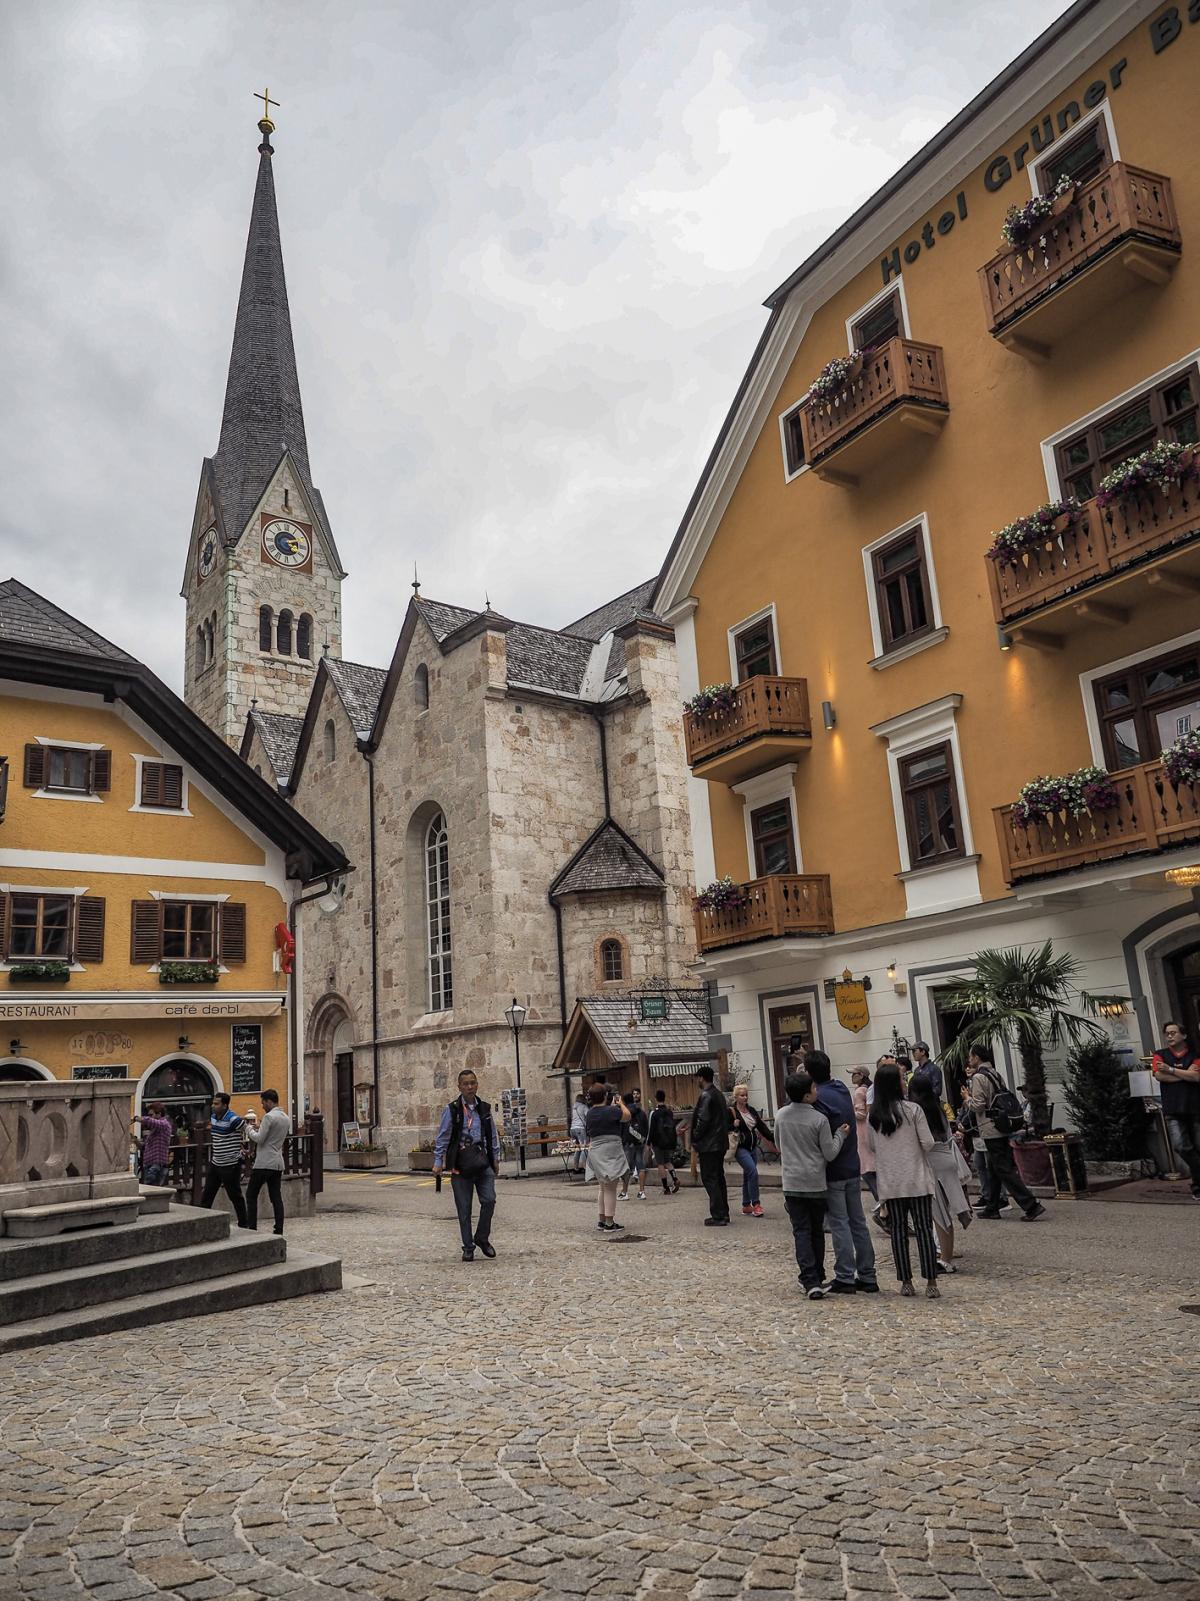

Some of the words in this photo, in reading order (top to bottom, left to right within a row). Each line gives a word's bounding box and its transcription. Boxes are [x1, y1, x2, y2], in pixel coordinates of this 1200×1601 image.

[880, 190, 968, 285] Hotel
[984, 57, 1128, 192] Grüner
[838, 995, 864, 1006] Kaiser
[0, 1005, 78, 1017] RESTAURANT
[165, 1004, 197, 1015] café
